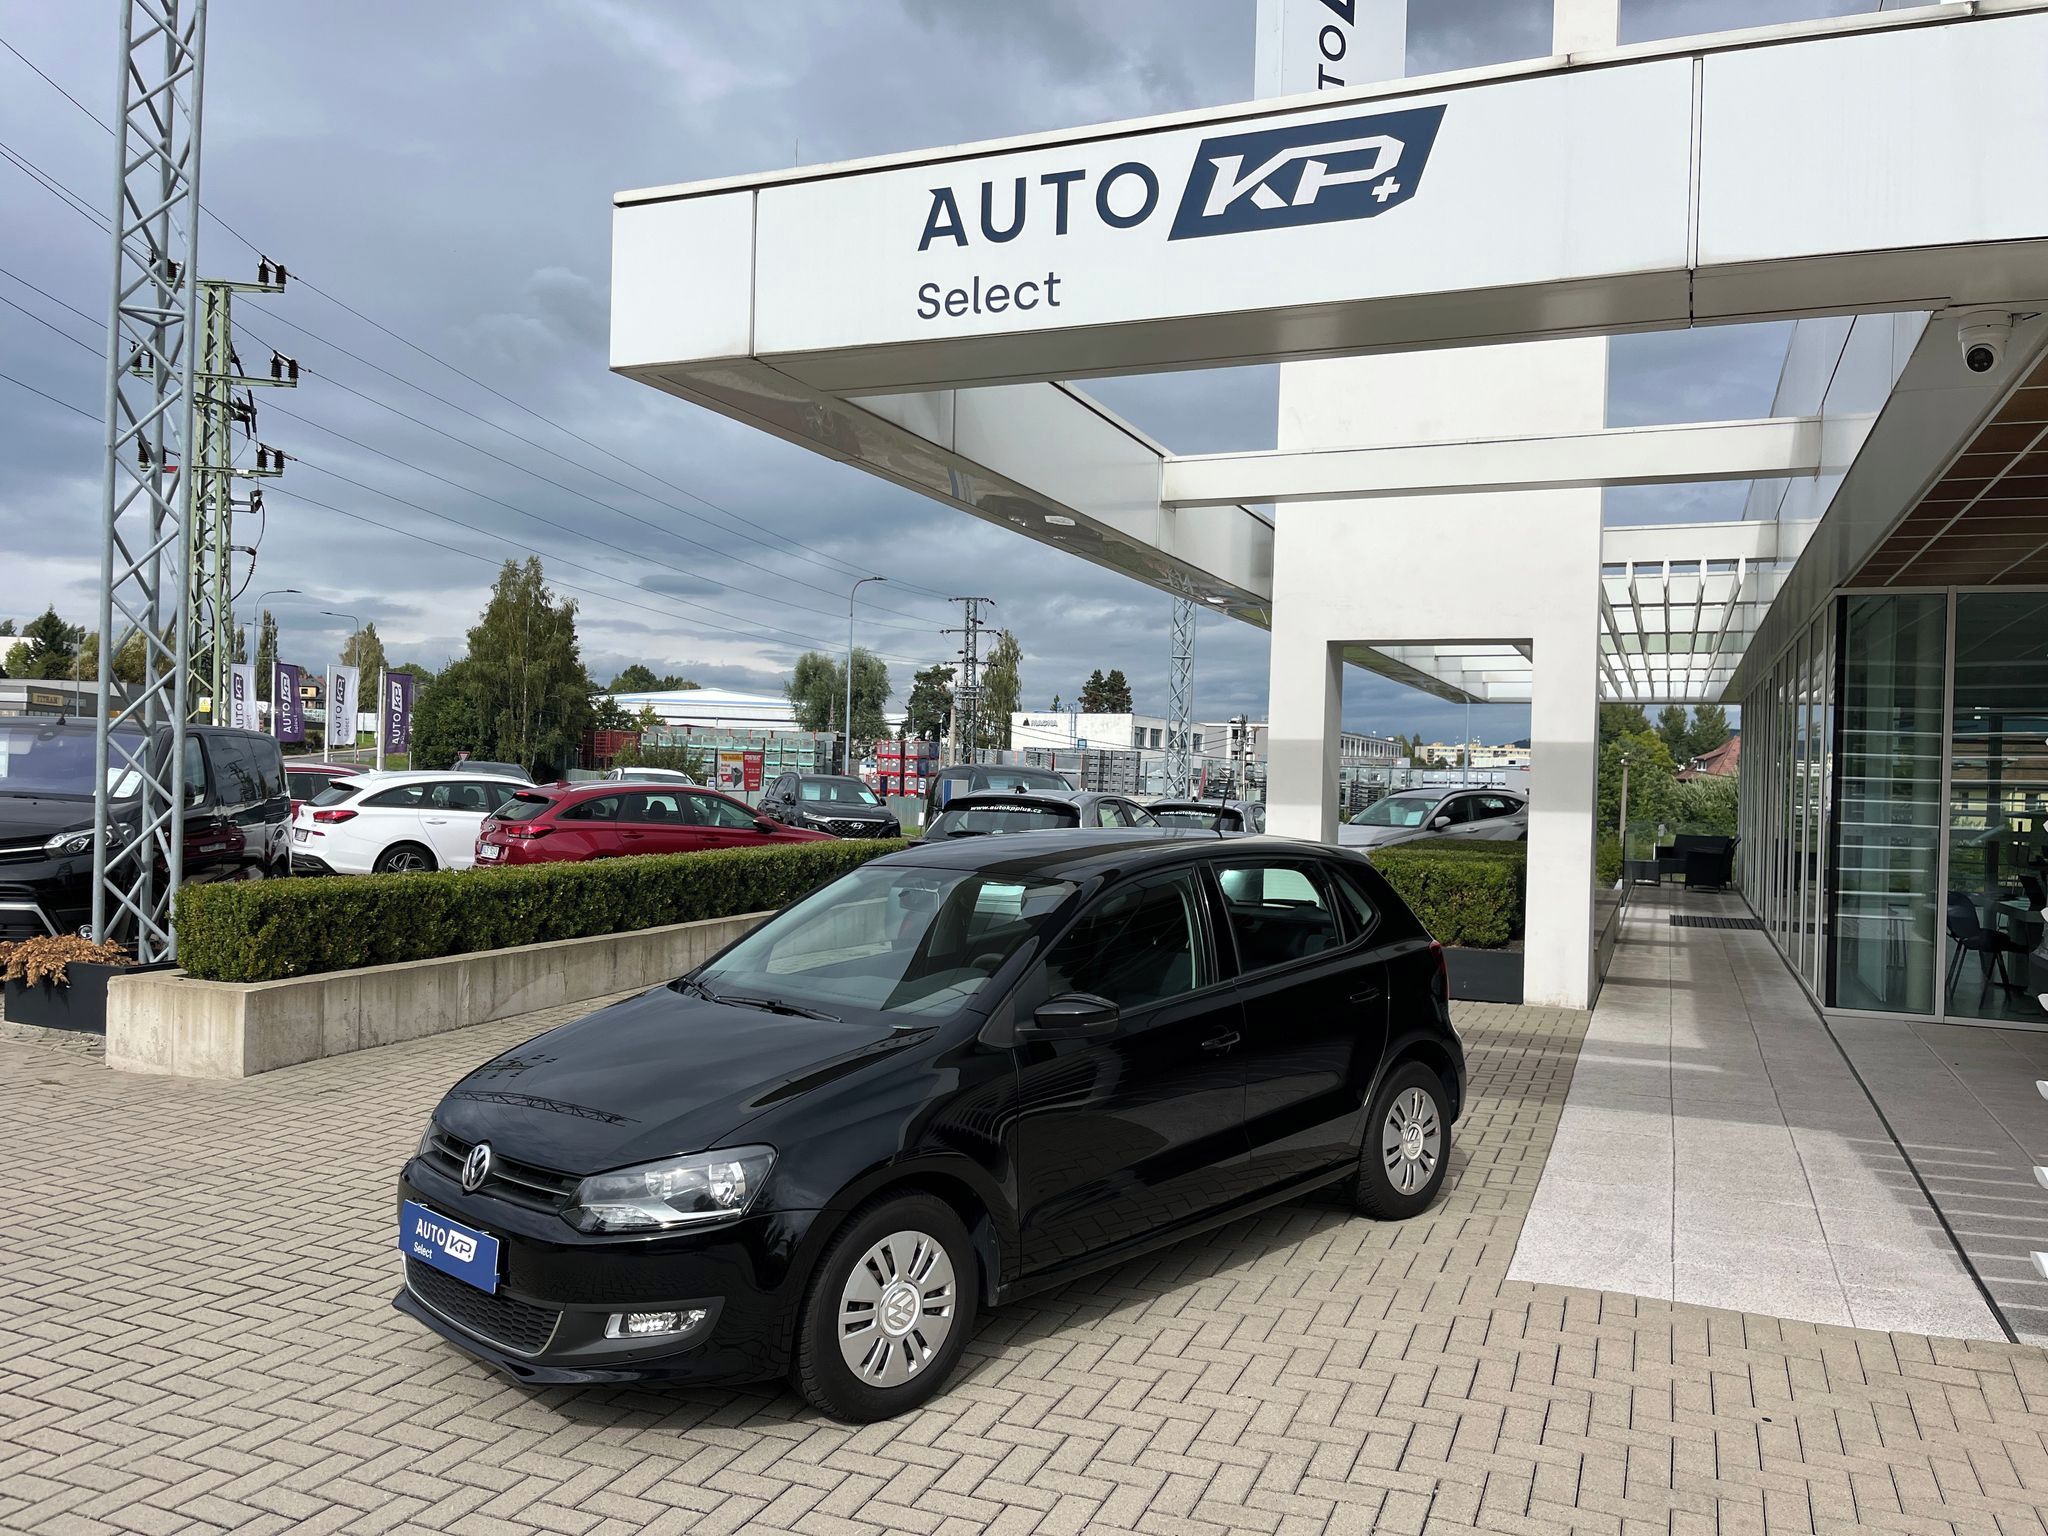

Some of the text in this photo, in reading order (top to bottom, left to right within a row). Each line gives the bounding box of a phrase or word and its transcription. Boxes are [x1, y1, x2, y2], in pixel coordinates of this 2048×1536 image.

[917, 161, 1159, 251] AUTO
[916, 271, 1061, 320] Select
[282, 702, 292, 734] AUTO
[392, 713, 402, 745] AUTO
[970, 804, 1042, 814] www.autokpplus.cz
[415, 1218, 446, 1246] AUTO
[413, 1241, 432, 1259] Select
